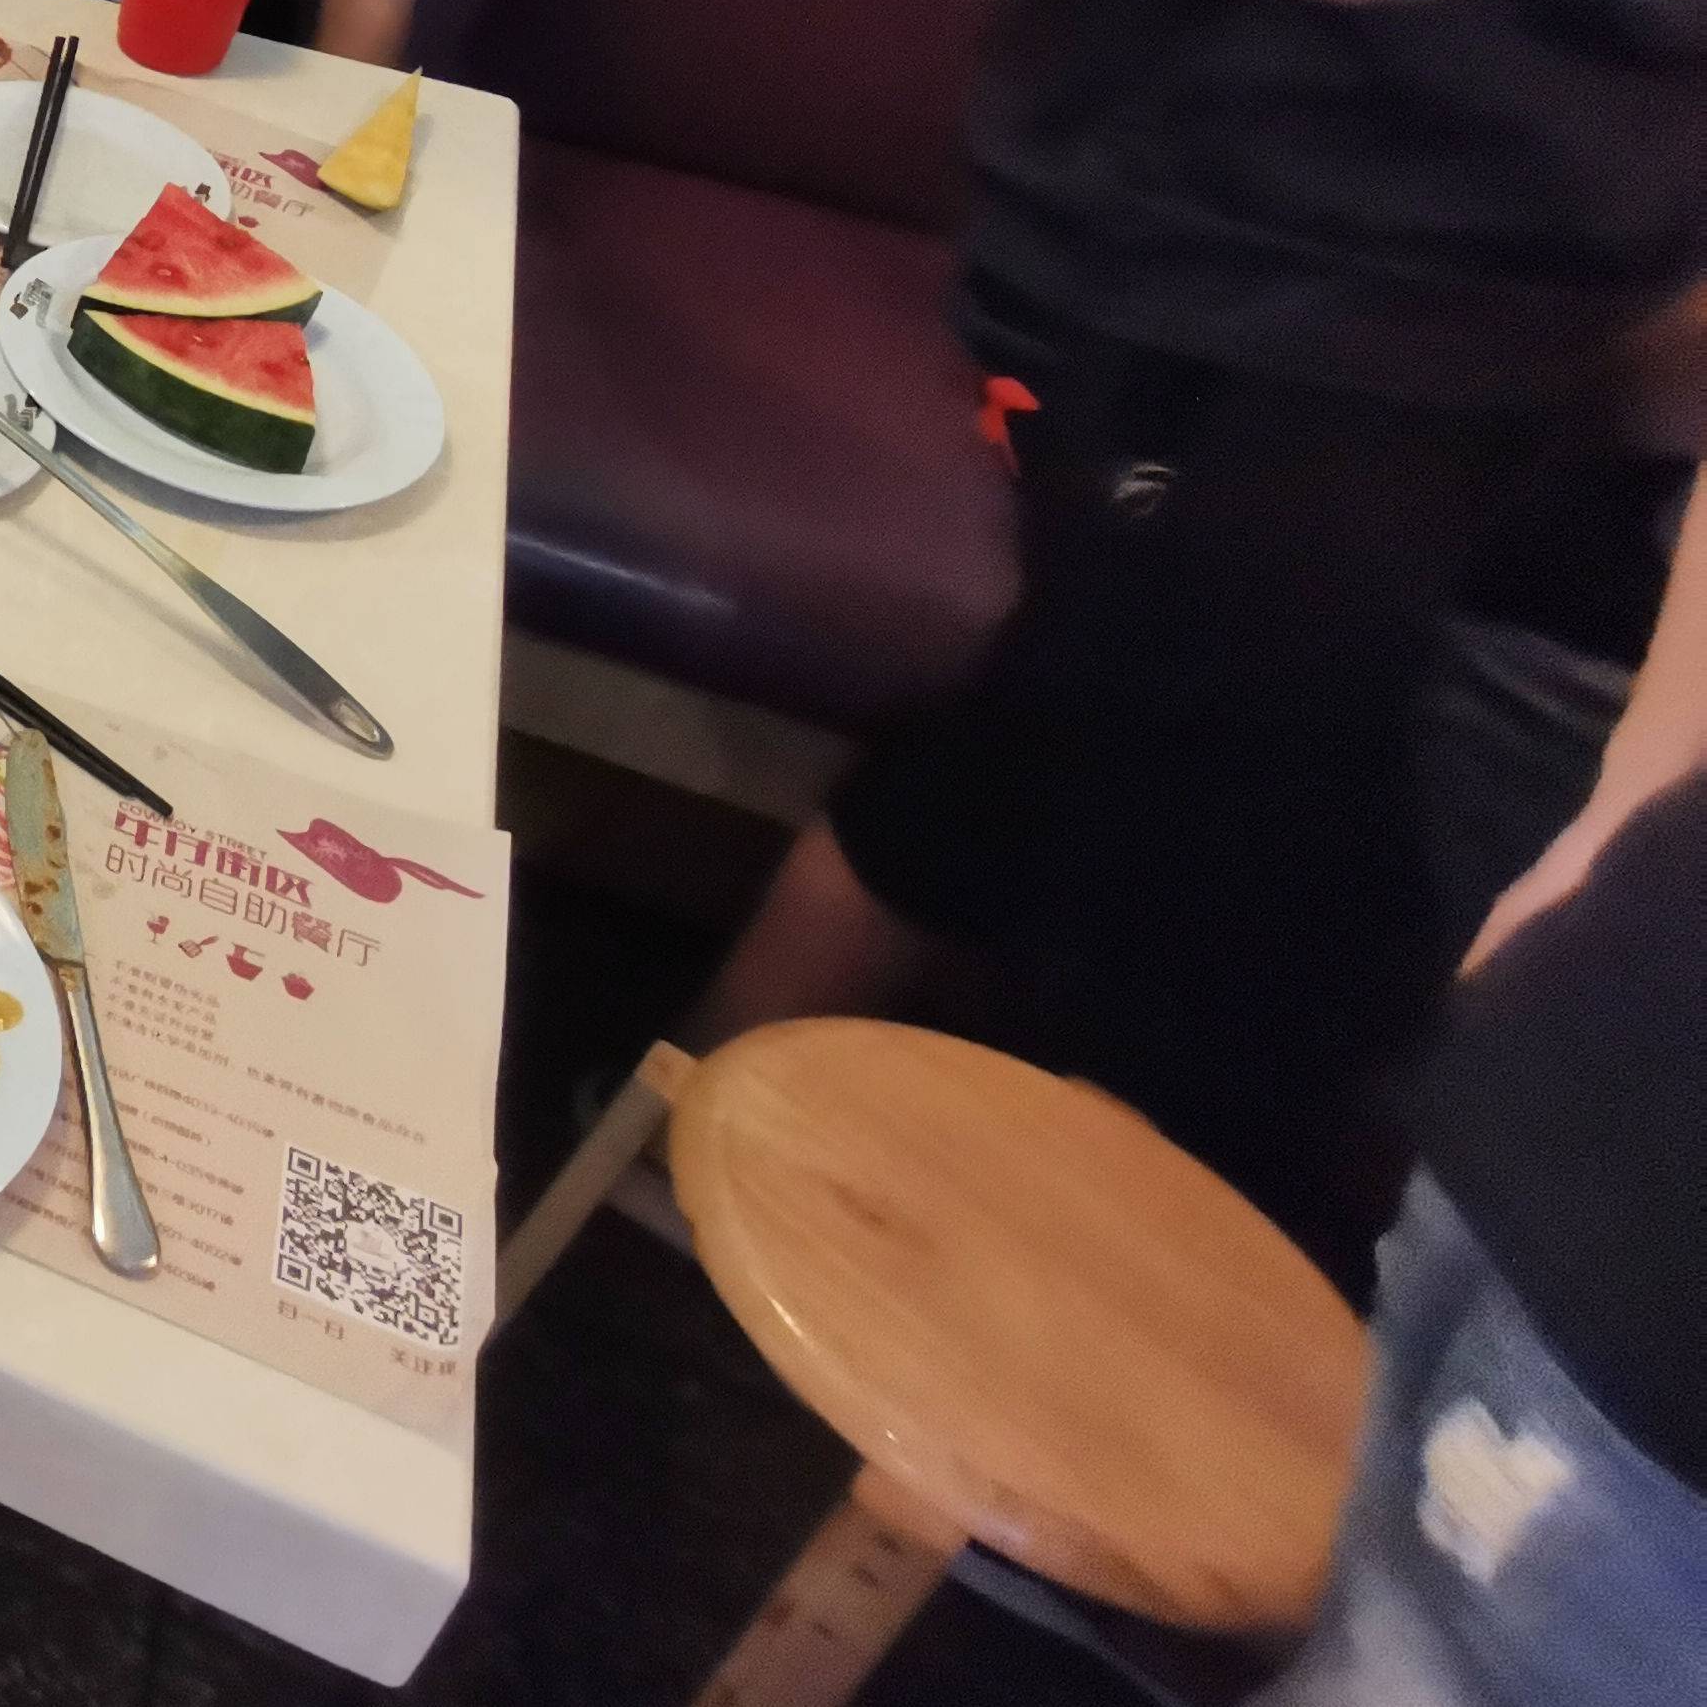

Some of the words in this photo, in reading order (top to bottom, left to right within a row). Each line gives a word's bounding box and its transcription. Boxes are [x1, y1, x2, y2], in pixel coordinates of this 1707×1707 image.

[104, 842, 382, 967] 时尚自助餐厅
[113, 808, 315, 908] 牛仔街区
